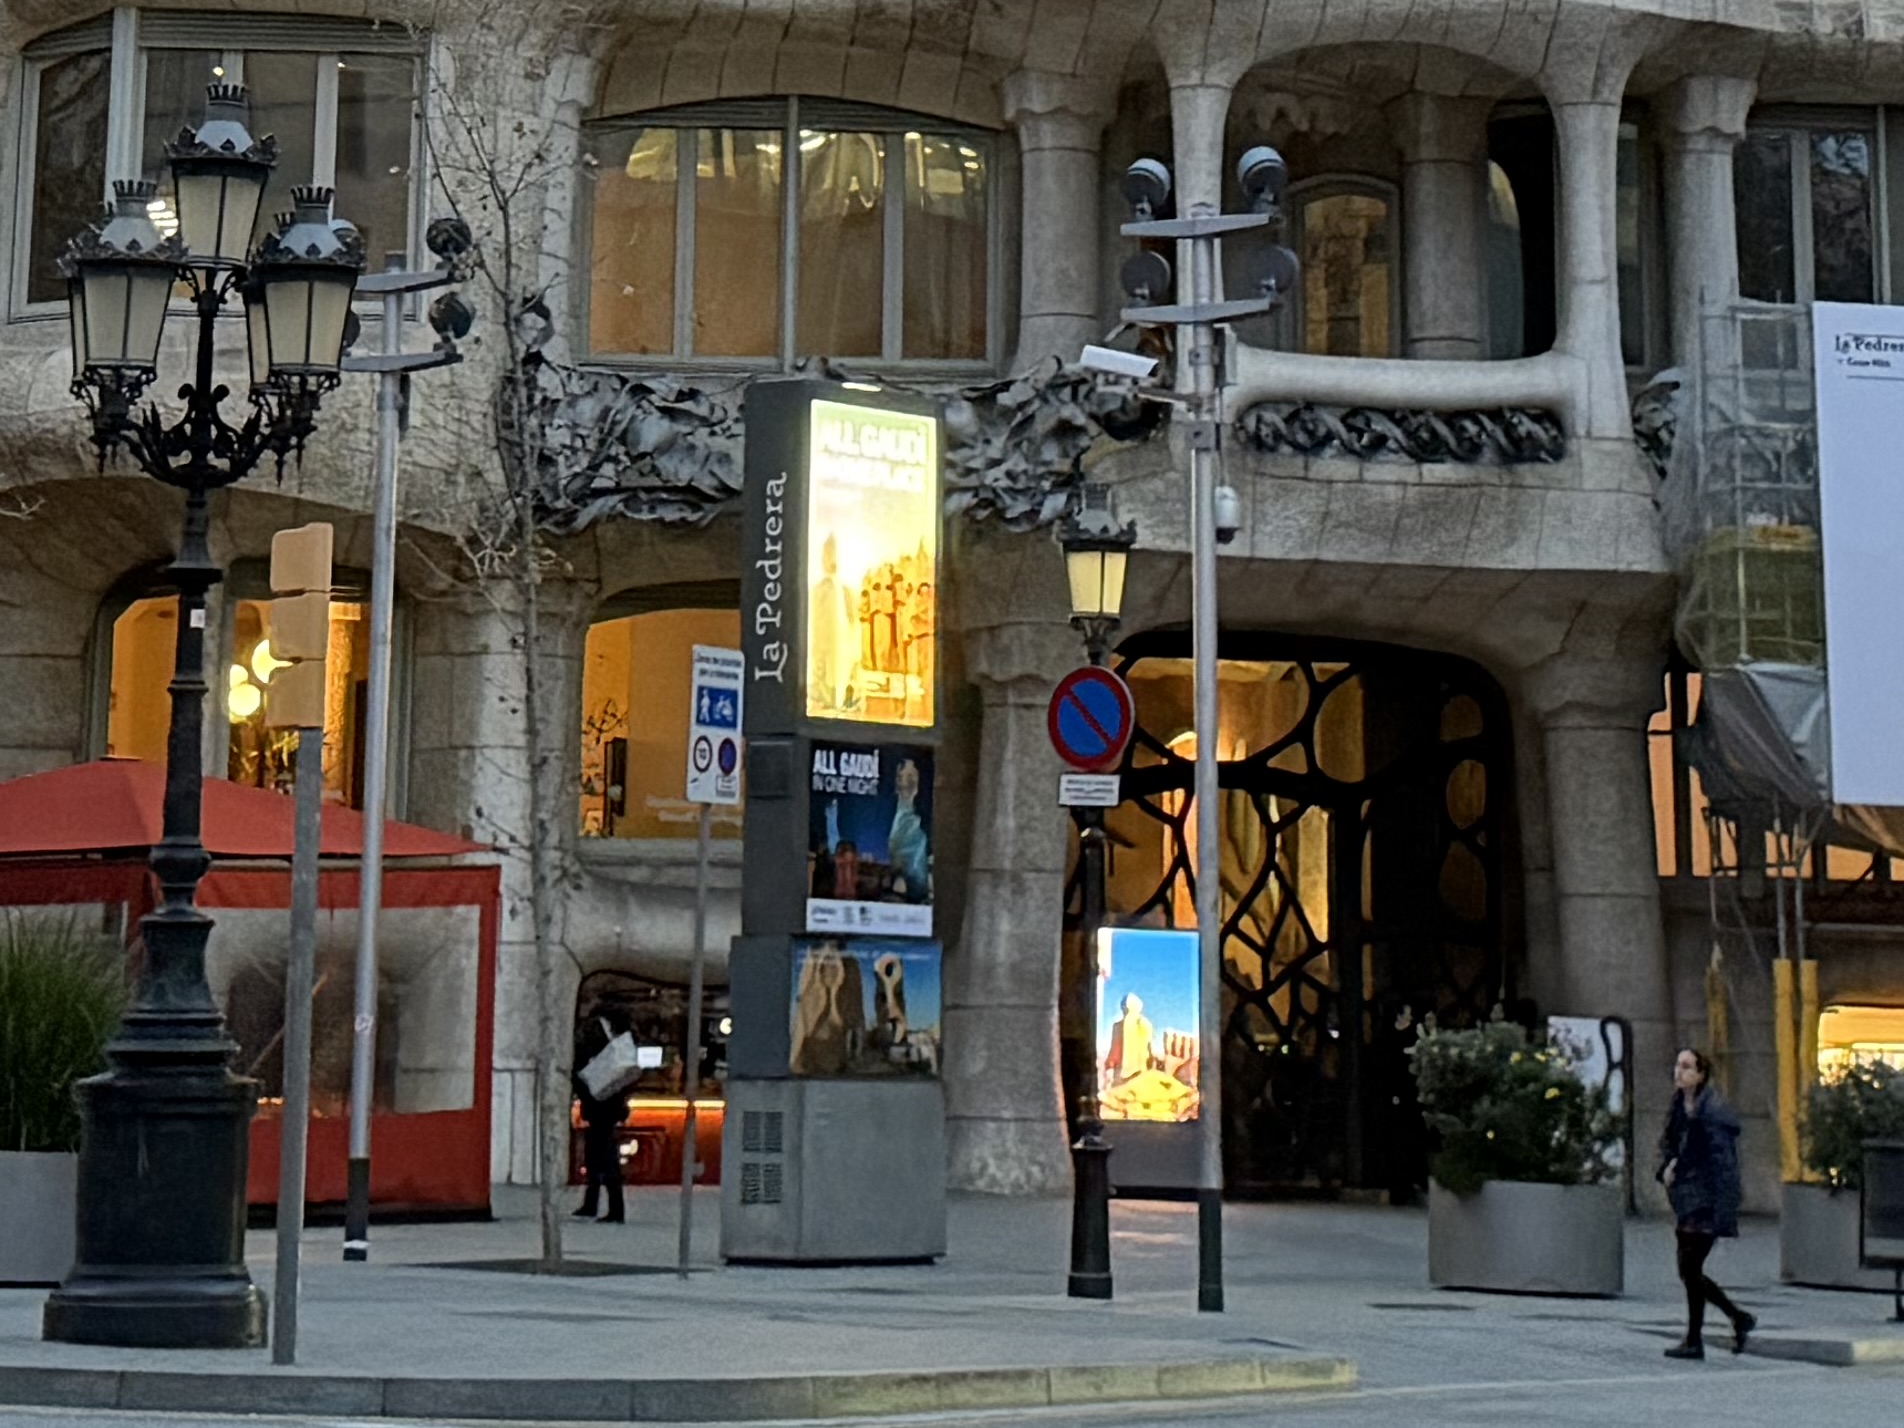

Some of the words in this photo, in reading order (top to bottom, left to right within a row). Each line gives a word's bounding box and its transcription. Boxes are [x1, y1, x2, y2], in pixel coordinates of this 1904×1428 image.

[755, 472, 788, 635] Pedrera
[754, 640, 788, 684] La
[813, 749, 837, 775] ALL
